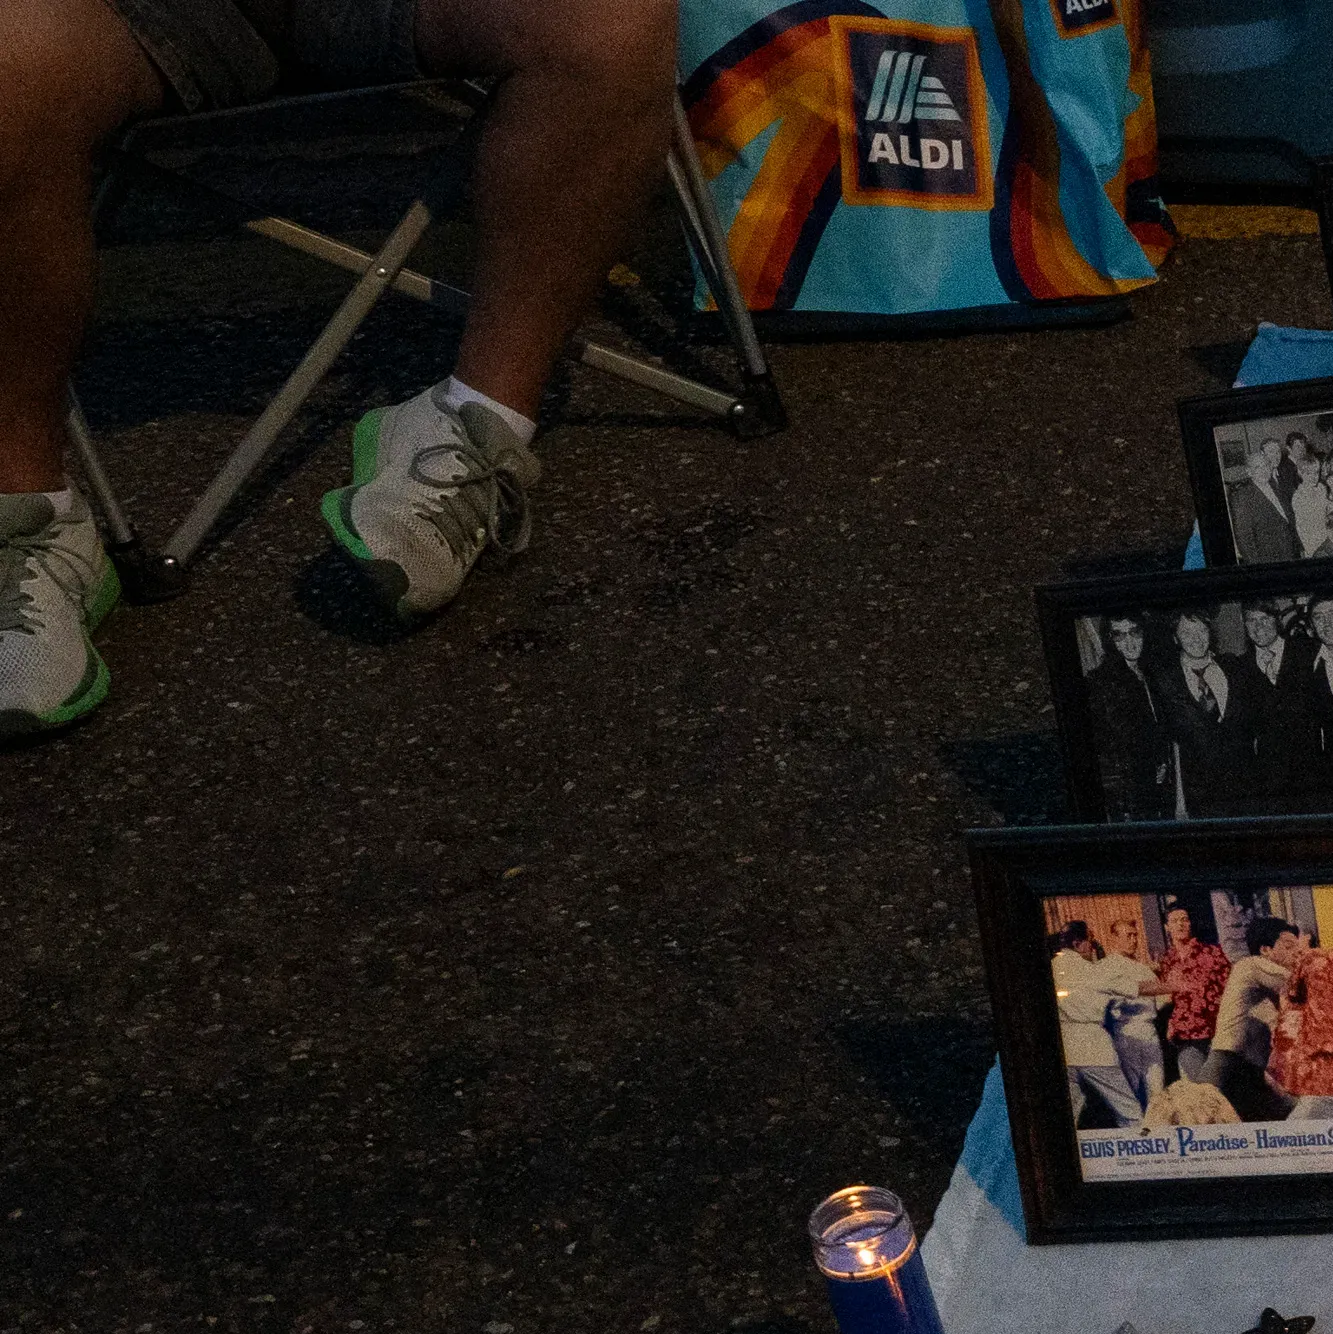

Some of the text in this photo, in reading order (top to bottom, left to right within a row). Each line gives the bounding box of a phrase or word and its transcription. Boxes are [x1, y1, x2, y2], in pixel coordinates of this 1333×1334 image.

[868, 133, 964, 170] ALDI
[1080, 1140, 1115, 1159] ELVIS
[1176, 1126, 1248, 1157] Paradise
[1255, 1129, 1328, 1149] Hawaiian
